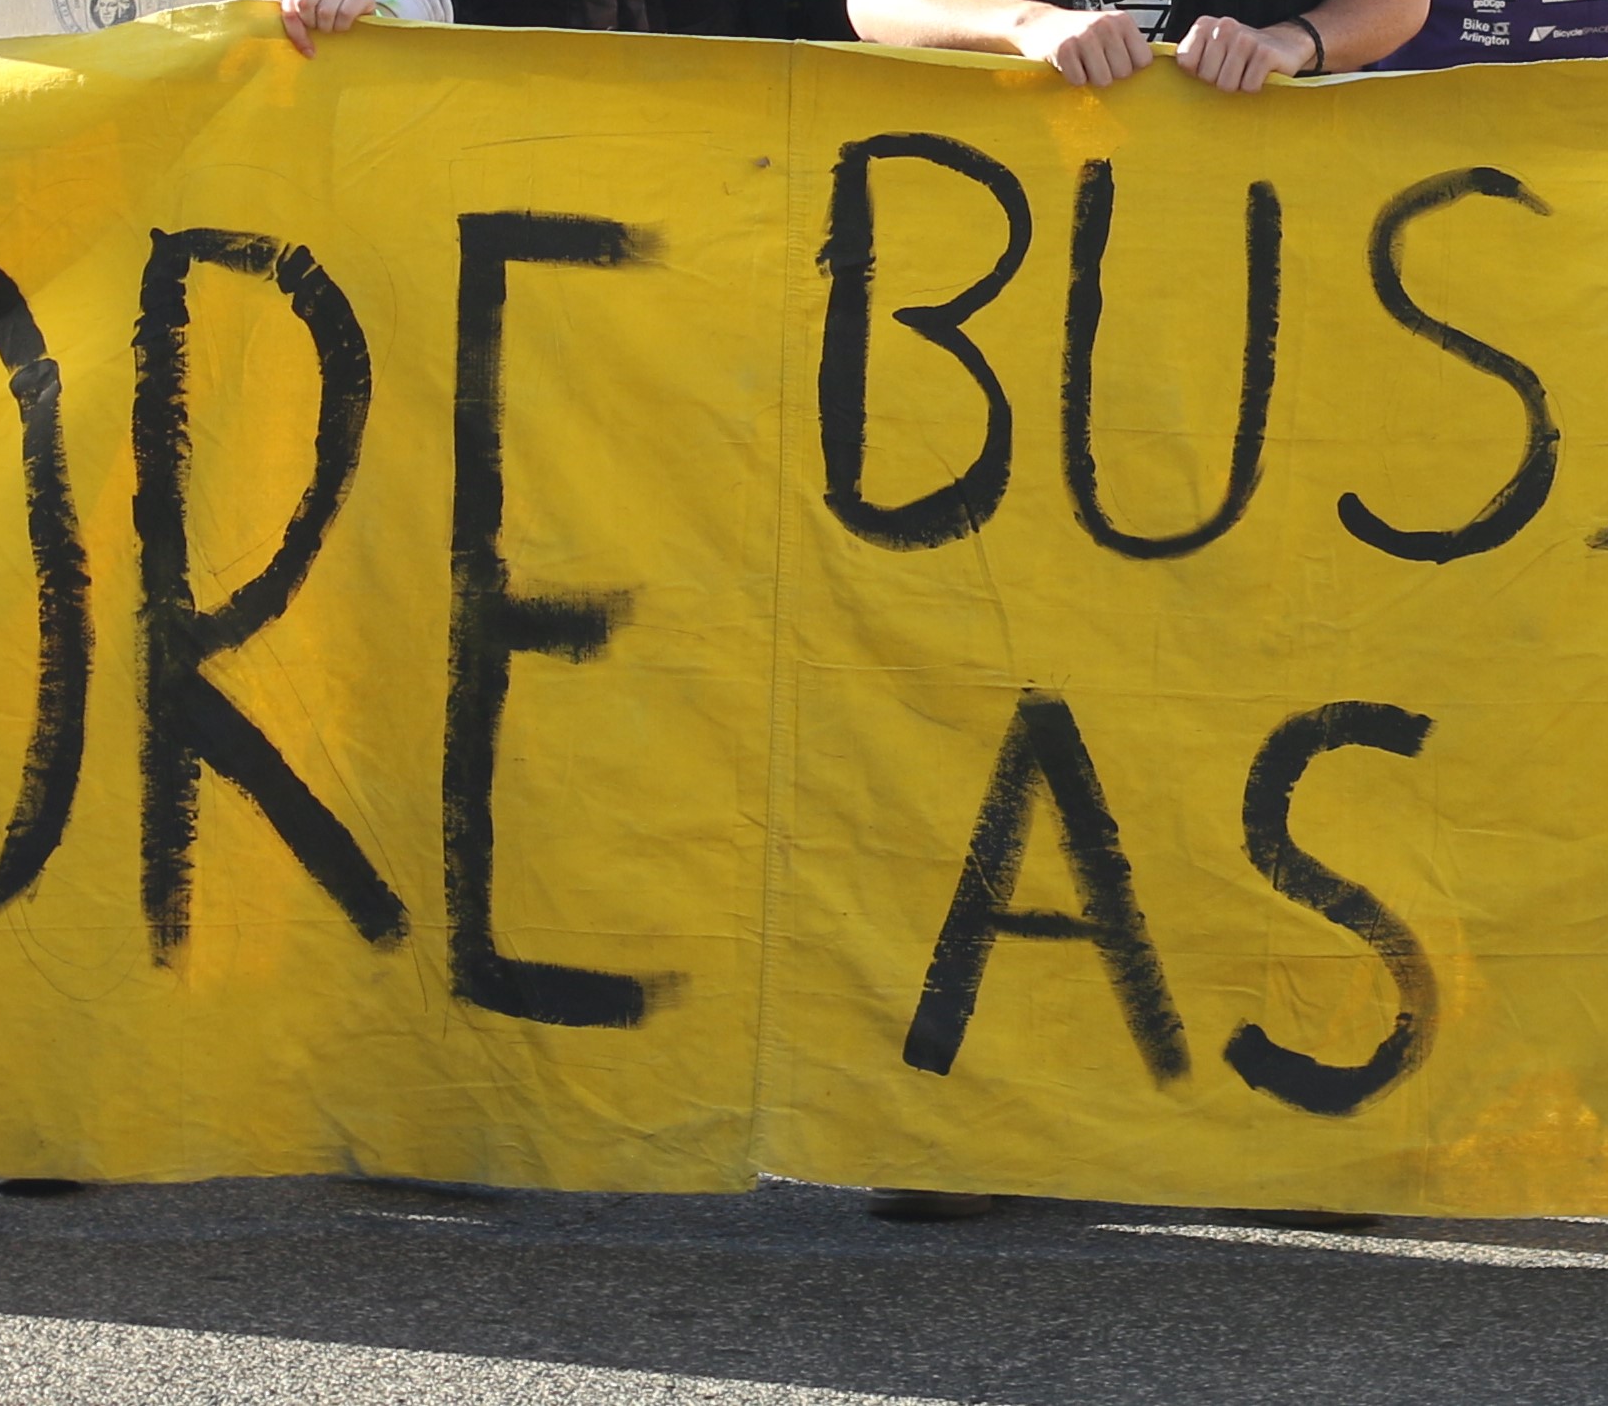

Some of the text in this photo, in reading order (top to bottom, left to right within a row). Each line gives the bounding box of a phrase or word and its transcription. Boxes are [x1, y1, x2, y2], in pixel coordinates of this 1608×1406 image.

[1463, 18, 1490, 32] Bike
[1460, 31, 1510, 46] Arlington
[901, 682, 1439, 1118] AS
